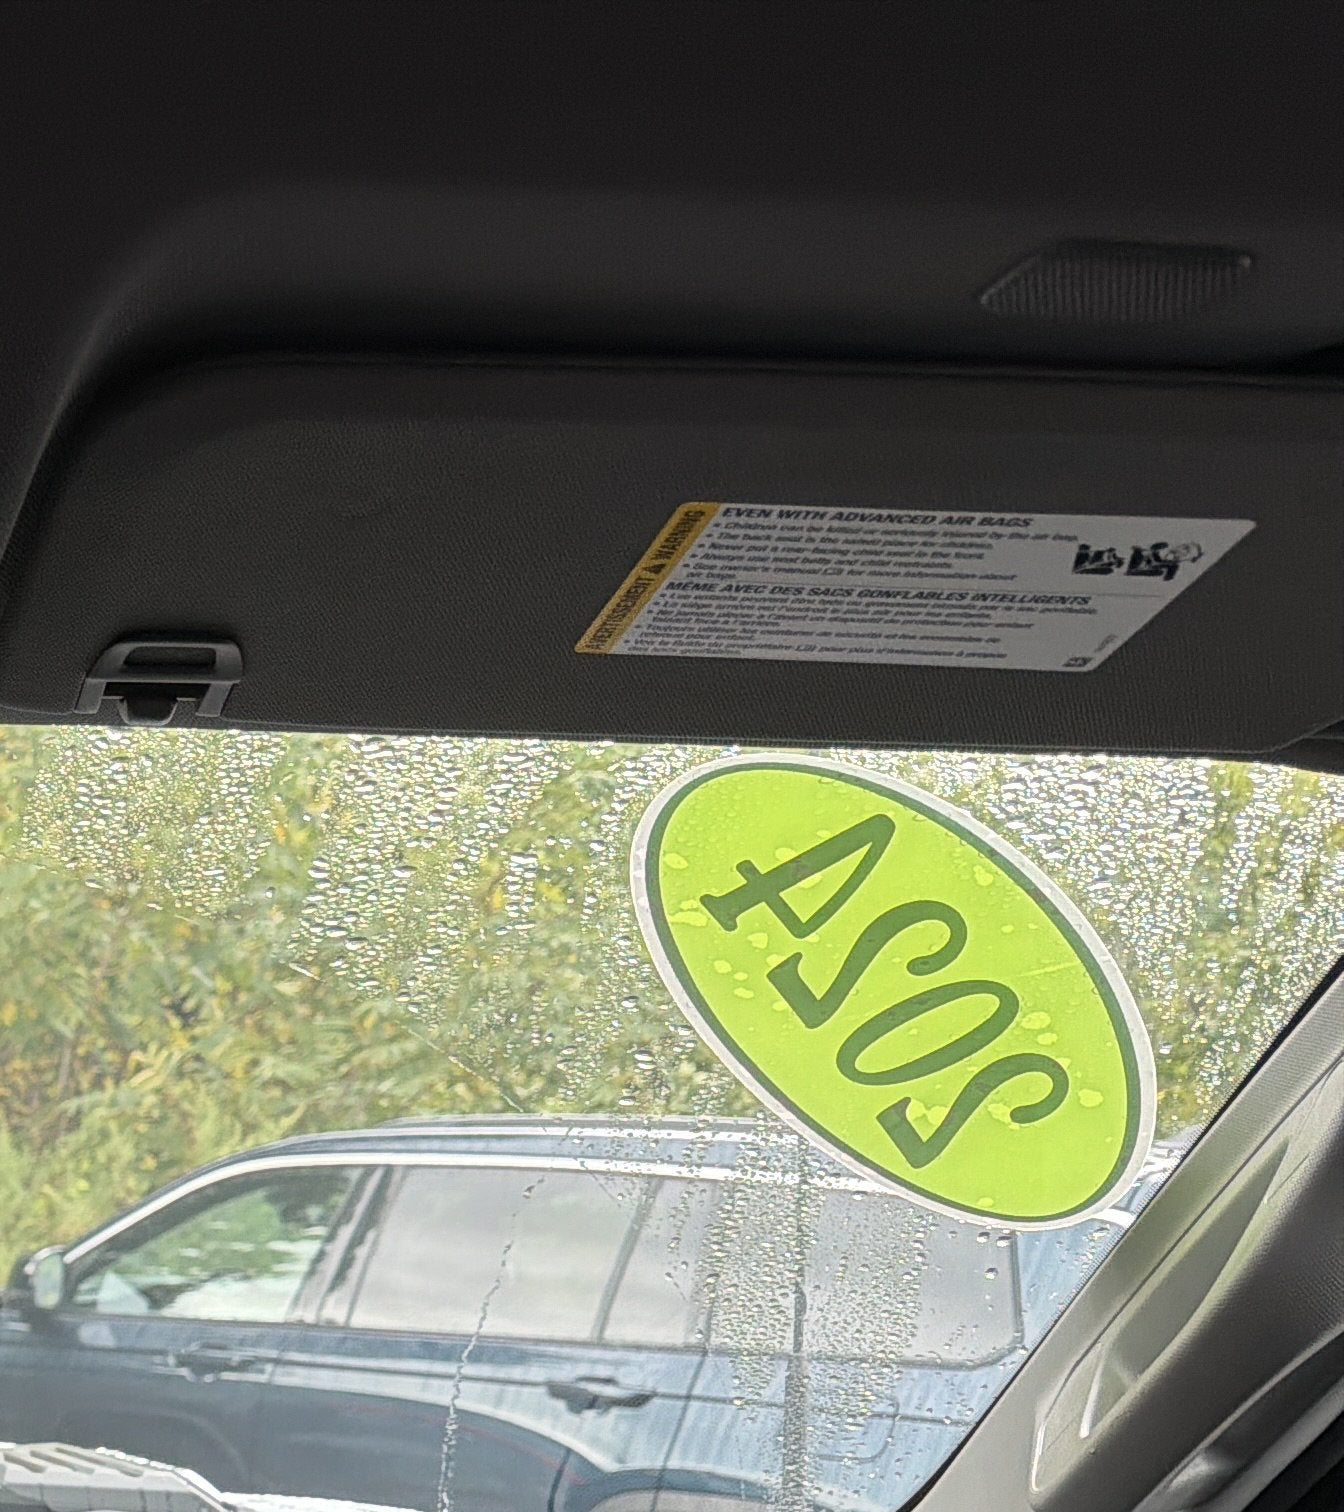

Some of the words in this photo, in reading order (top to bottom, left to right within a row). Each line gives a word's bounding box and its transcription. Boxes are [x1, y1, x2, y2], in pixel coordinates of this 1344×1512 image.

[722, 507, 774, 518] EVEN
[777, 509, 825, 520] WITH
[829, 511, 937, 525] ADVANCED
[939, 515, 976, 526] AIR
[977, 517, 1034, 528] BAGS
[720, 583, 767, 594] AVEC
[769, 585, 805, 597] DES
[808, 587, 855, 597] SACS
[857, 588, 969, 601] GONFLABLES
[971, 592, 1092, 605] INTELLIGENTS
